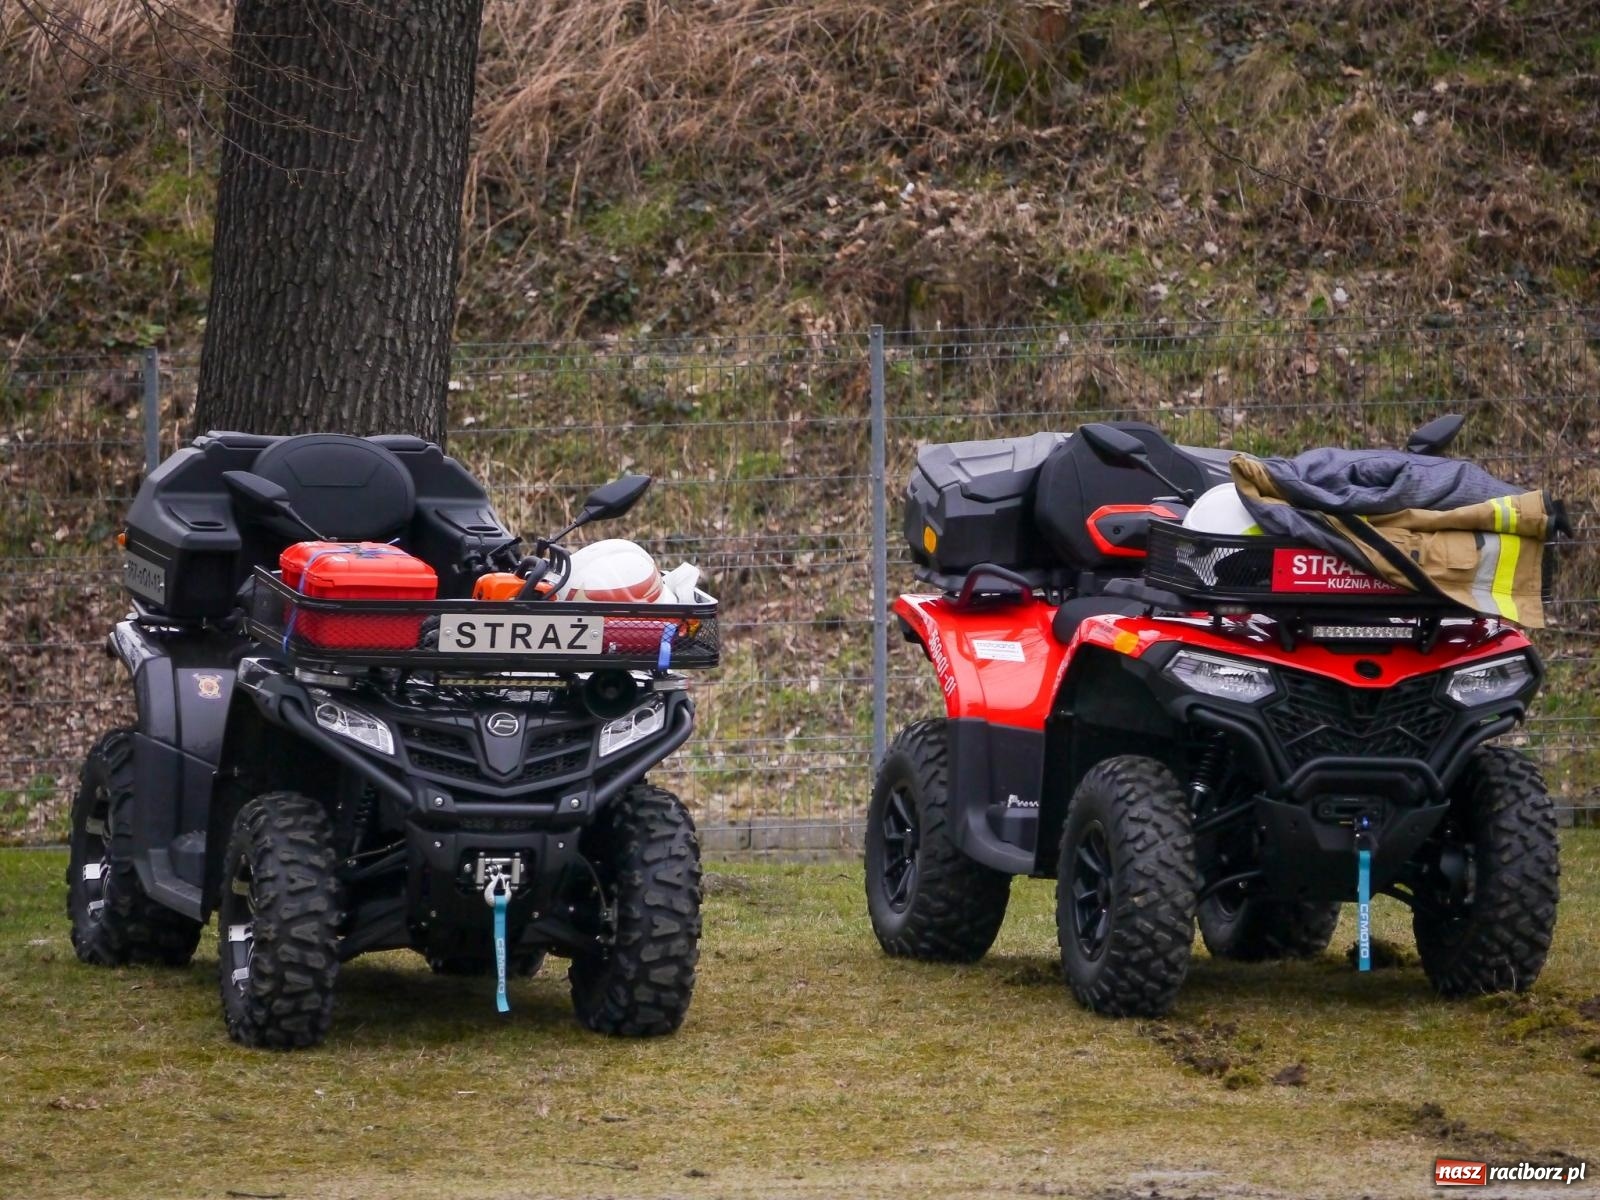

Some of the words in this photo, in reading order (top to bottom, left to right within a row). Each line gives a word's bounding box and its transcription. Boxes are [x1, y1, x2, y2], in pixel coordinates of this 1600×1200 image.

[1328, 576, 1371, 589] KUŹNIA
[455, 618, 589, 649] STRAŻ
[1360, 905, 1369, 958] CFMOTO
